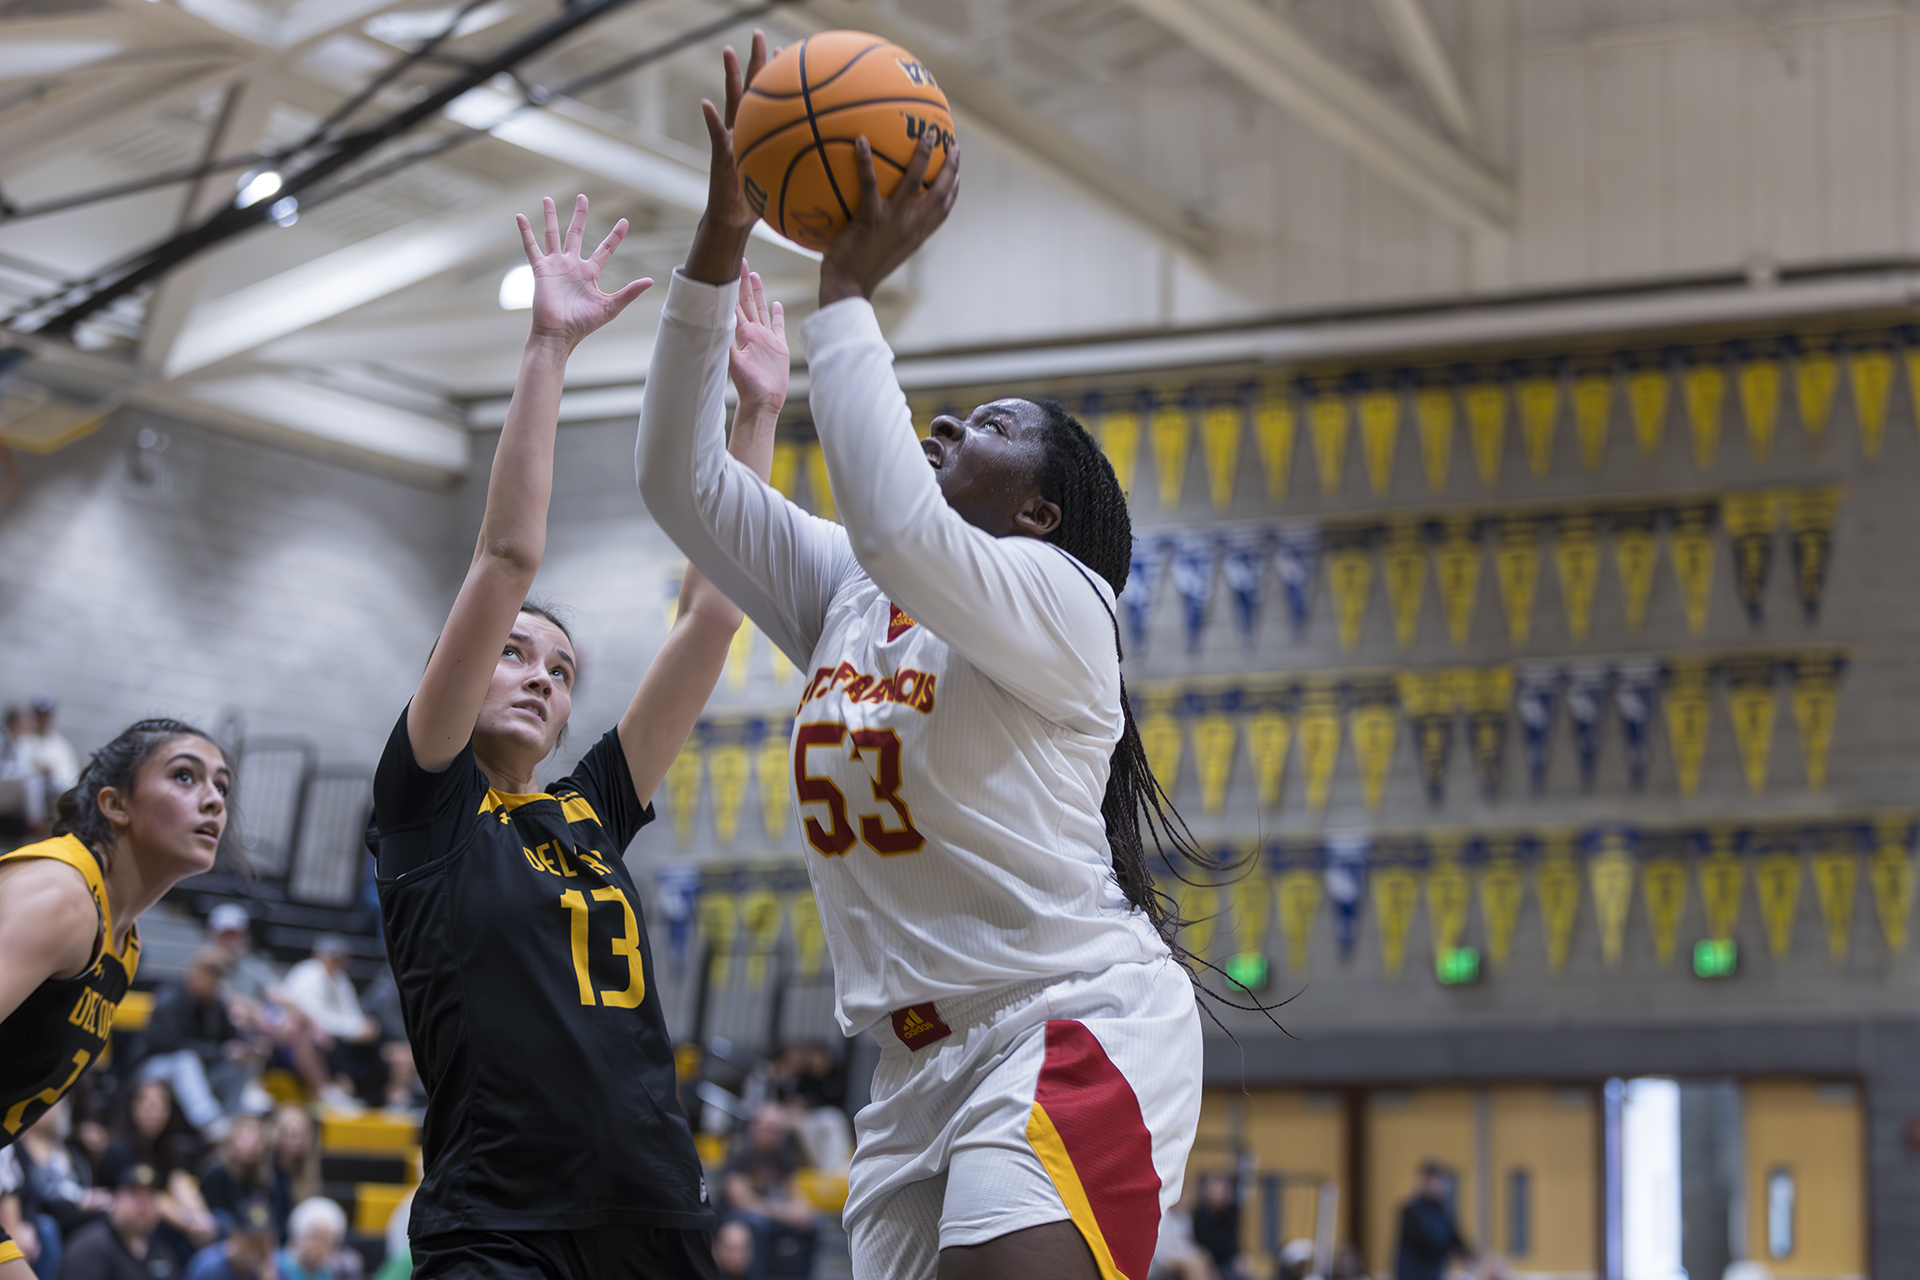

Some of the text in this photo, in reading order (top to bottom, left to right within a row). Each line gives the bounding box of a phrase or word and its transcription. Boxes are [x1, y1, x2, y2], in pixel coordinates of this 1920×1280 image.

[794, 721, 926, 858] 53
[522, 839, 578, 877] DEL
[560, 885, 645, 1009] 13
[68, 985, 103, 1034] DEL
[904, 1021, 934, 1039] adidas
[3, 1048, 91, 1136] 2
